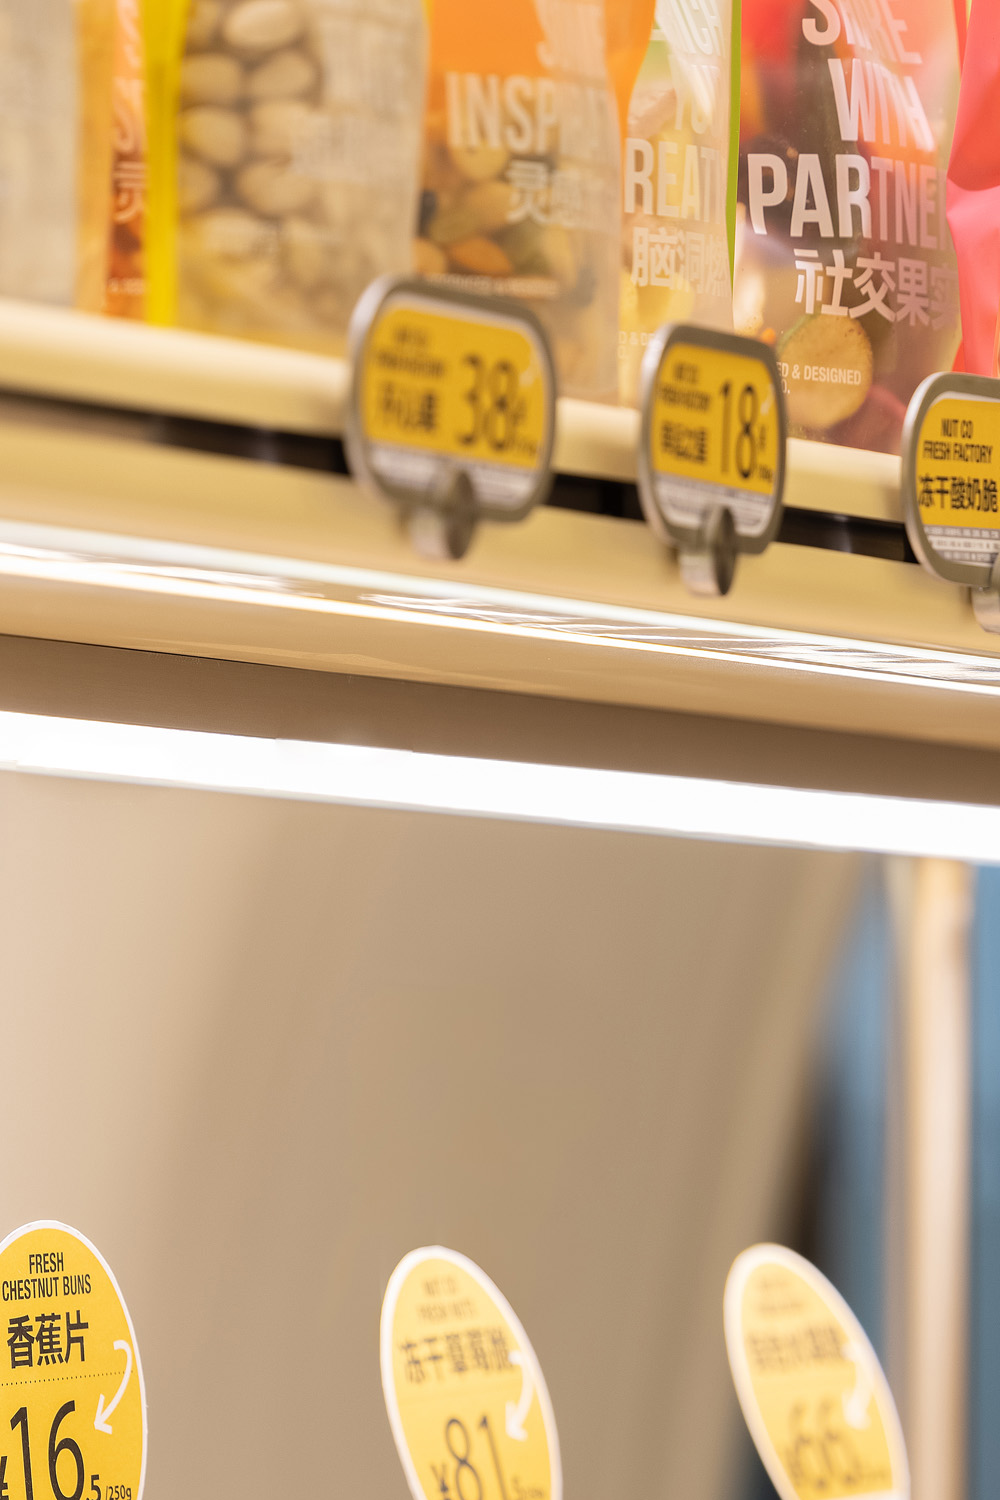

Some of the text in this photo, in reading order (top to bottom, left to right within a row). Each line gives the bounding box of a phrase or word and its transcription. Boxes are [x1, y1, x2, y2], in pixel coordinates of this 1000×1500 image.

[791, 364, 801, 379] &
[803, 365, 862, 386] DESIGNED
[718, 378, 760, 480] 18
[941, 418, 974, 439] NUT CO
[922, 440, 994, 464] FRESH FACTORY
[29, 1252, 65, 1275] FRESH
[2, 1274, 92, 1301] CHESTNUT BUNS
[6, 1310, 89, 1369] 香蕉片
